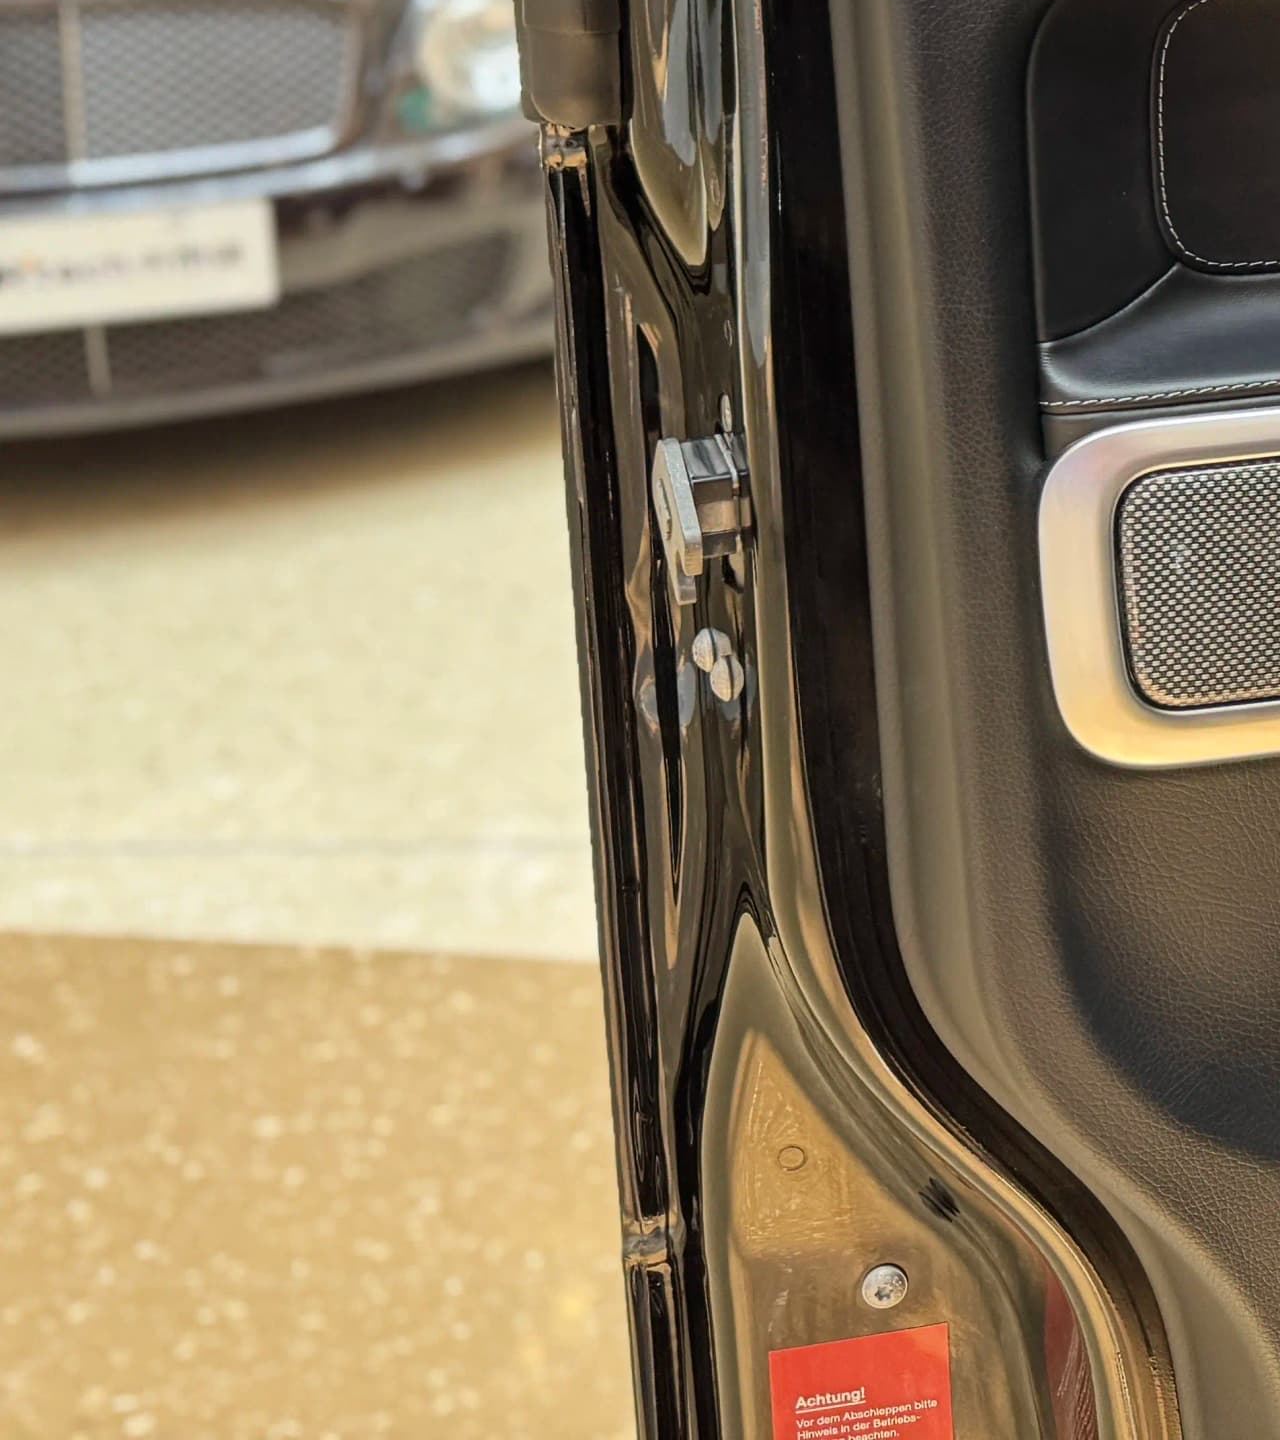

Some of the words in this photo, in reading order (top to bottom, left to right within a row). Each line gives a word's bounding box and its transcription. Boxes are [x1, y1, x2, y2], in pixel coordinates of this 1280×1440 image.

[795, 1387, 866, 1409] Achtung!
[796, 1419, 814, 1429] Vor
[817, 1414, 840, 1426] dem
[843, 1403, 912, 1421] Abschleppen
[914, 1399, 938, 1411] bitte
[797, 1427, 839, 1440] Hinweis
[841, 1423, 850, 1434] in
[853, 1420, 871, 1431] der
[873, 1414, 922, 1429] Betriebs-
